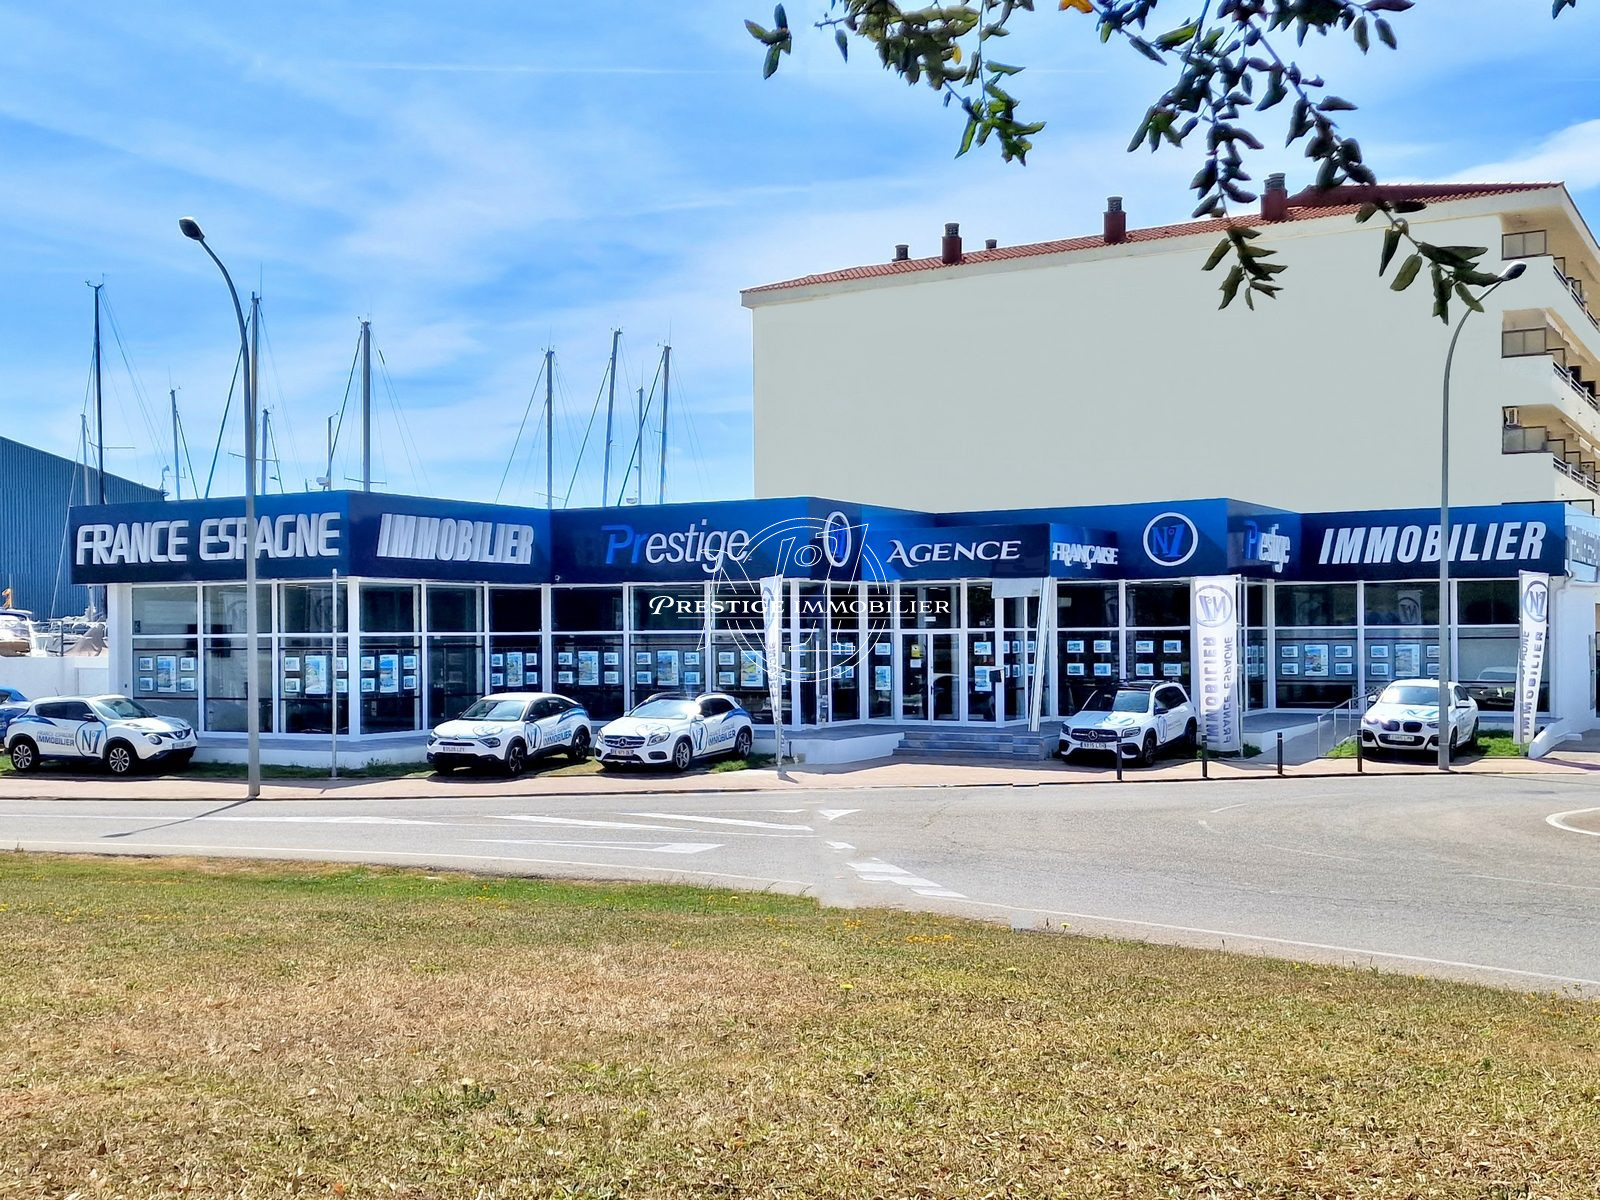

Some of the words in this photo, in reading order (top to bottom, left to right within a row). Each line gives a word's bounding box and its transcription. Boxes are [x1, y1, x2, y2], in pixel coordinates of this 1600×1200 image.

[76, 520, 189, 565] FRANCE
[199, 512, 341, 561] ESPAGNE
[376, 513, 534, 565] IMMOBILIER
[601, 519, 750, 573] Prestige
[886, 540, 1022, 568] AGENCE
[1318, 521, 1547, 565] IMMOBILIER
[1523, 631, 1543, 736] IMMOBILIER
[37, 735, 75, 747] IMMOBILIER
